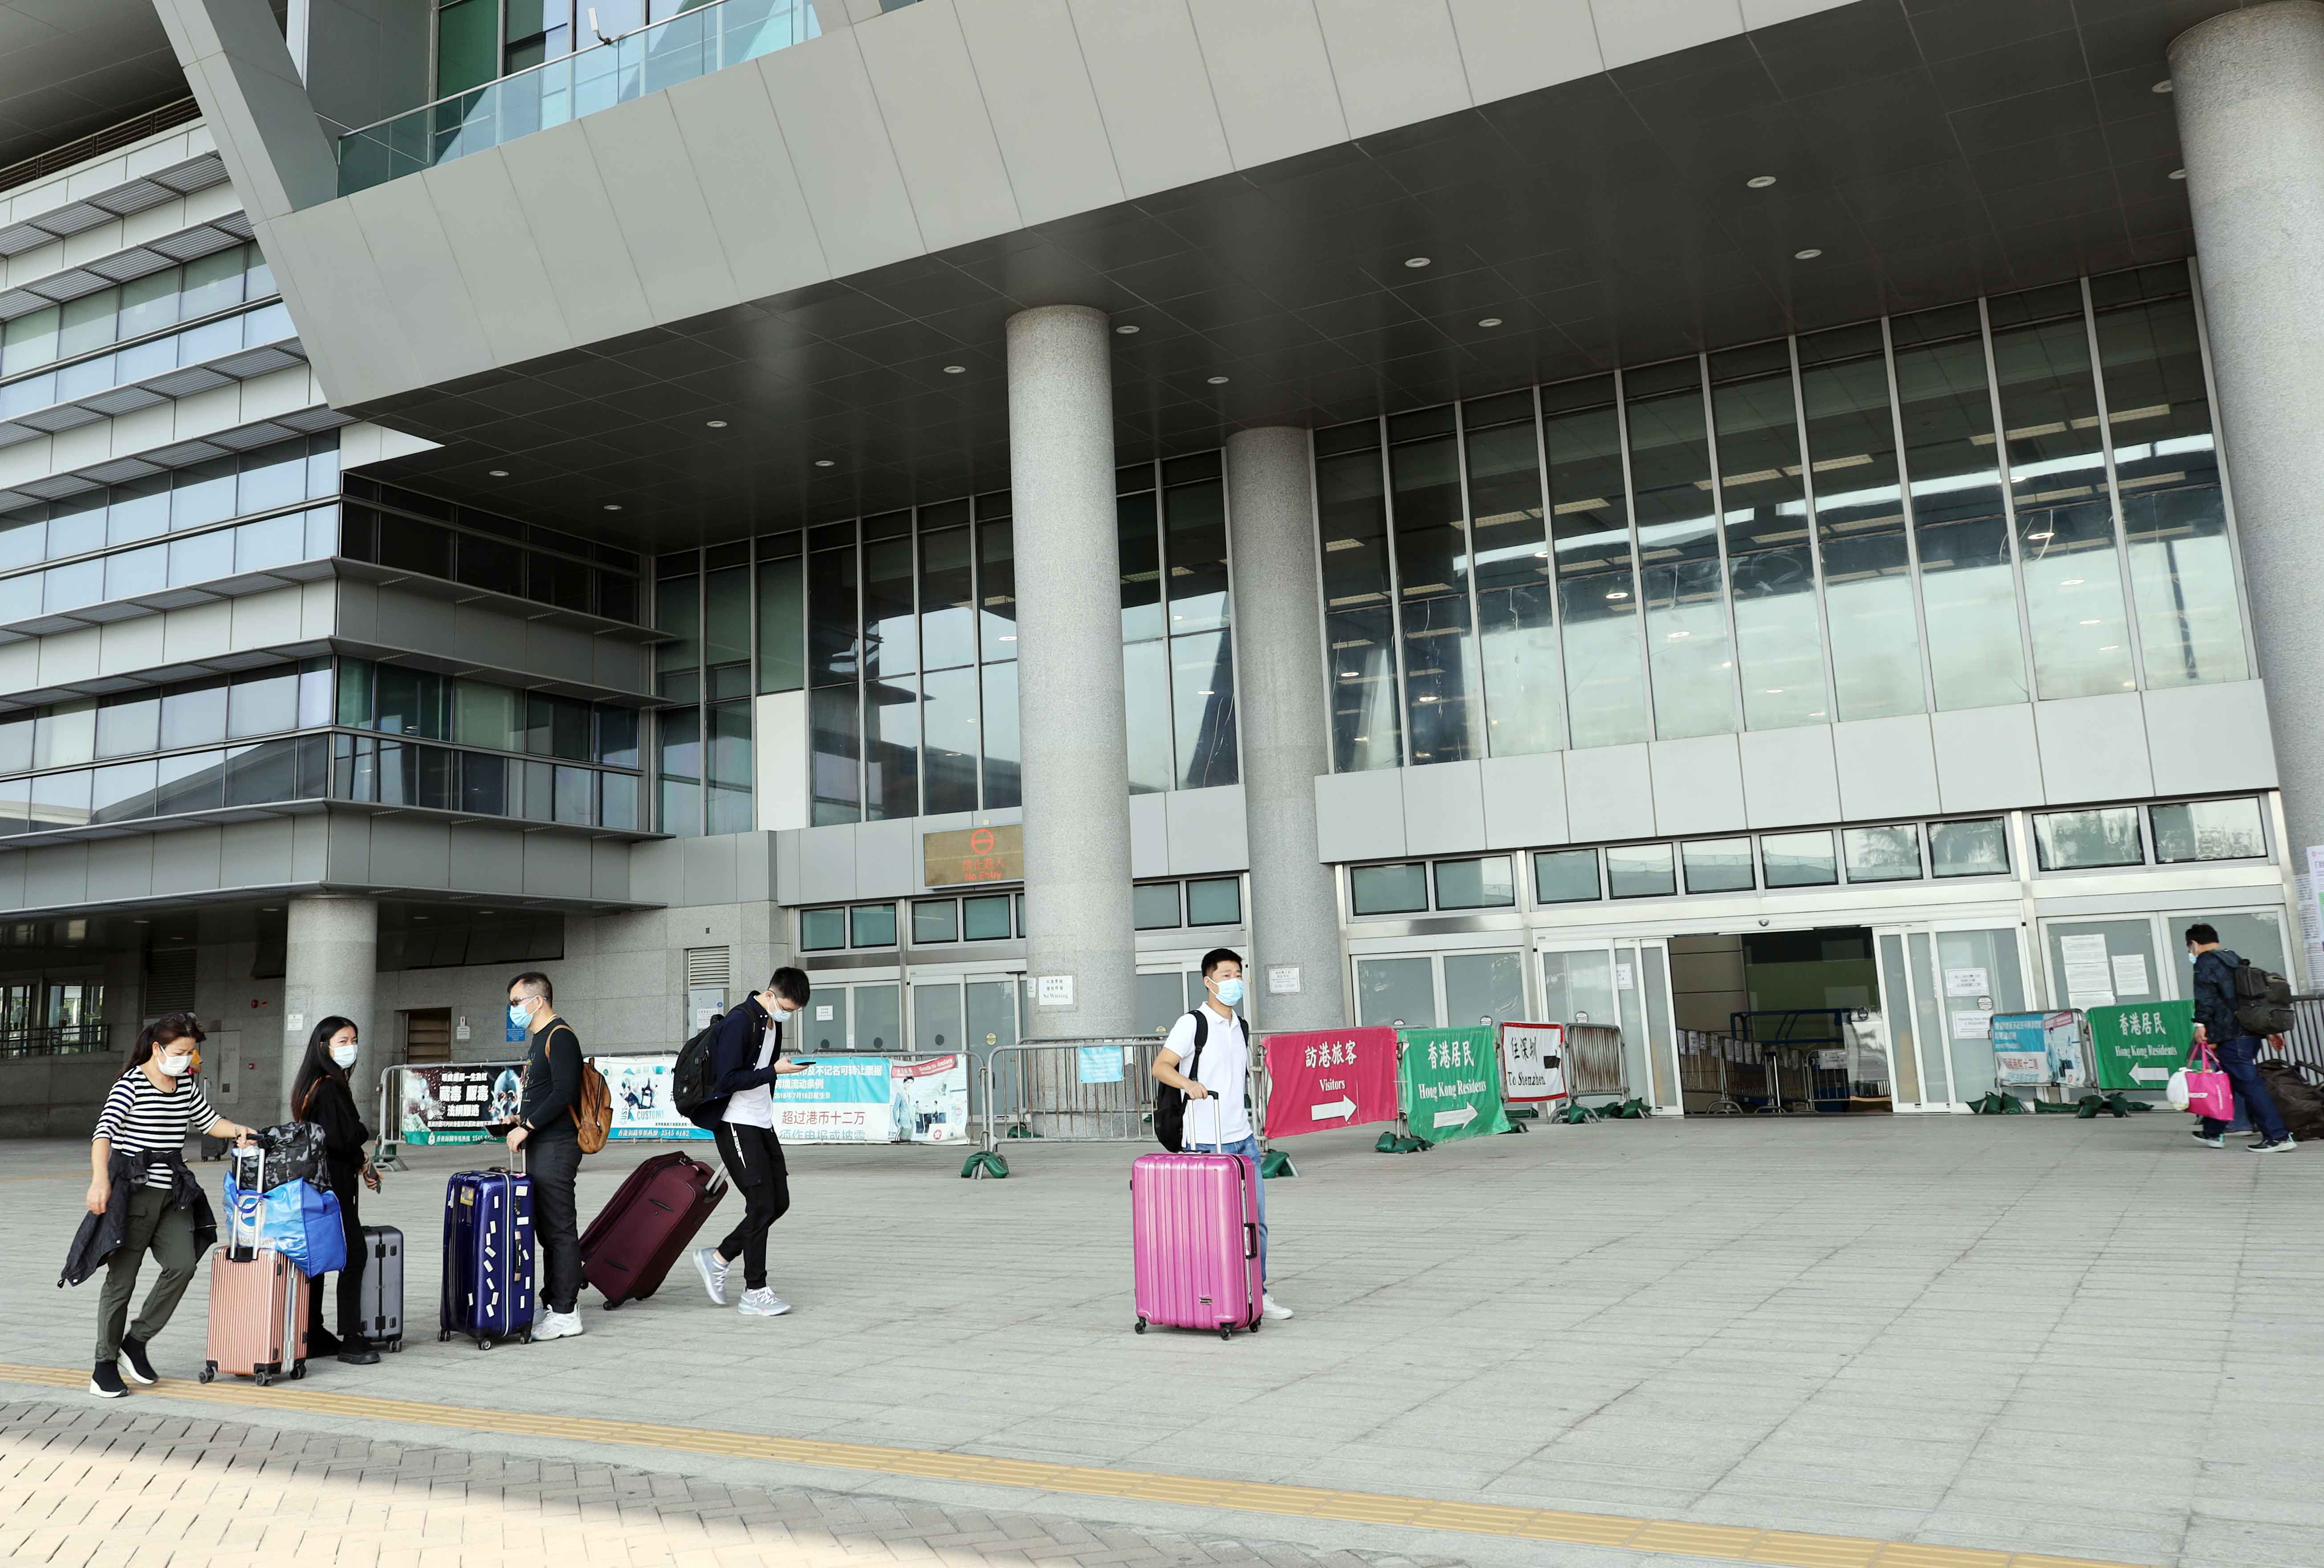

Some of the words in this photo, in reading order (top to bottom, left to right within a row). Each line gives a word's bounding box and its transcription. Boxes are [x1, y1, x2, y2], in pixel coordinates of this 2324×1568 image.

[965, 872, 976, 881] No
[979, 871, 1001, 880] Entry
[2119, 1011, 2167, 1036] 香港居民
[1304, 1040, 1357, 1068] 訪港旅客
[1428, 1040, 1475, 1069] 香港居民
[2115, 1046, 2131, 1059] Hong
[2130, 1045, 2148, 1059] Kong
[2147, 1044, 2178, 1056] Residents
[937, 1058, 953, 1066] declare
[777, 1065, 883, 1076] 币及不记名可转让票据
[775, 1078, 824, 1089] 跨境流动条例
[1319, 1078, 1345, 1092] Visitors
[1507, 1072, 1515, 1085] To
[1518, 1072, 1546, 1086] Shenzhen
[1418, 1083, 1438, 1101] Hong
[1438, 1082, 1457, 1099] Kong
[1457, 1079, 1487, 1095] Residents
[637, 1110, 665, 1120] CUSTOMS
[782, 1111, 866, 1125] 超过港币十二万
